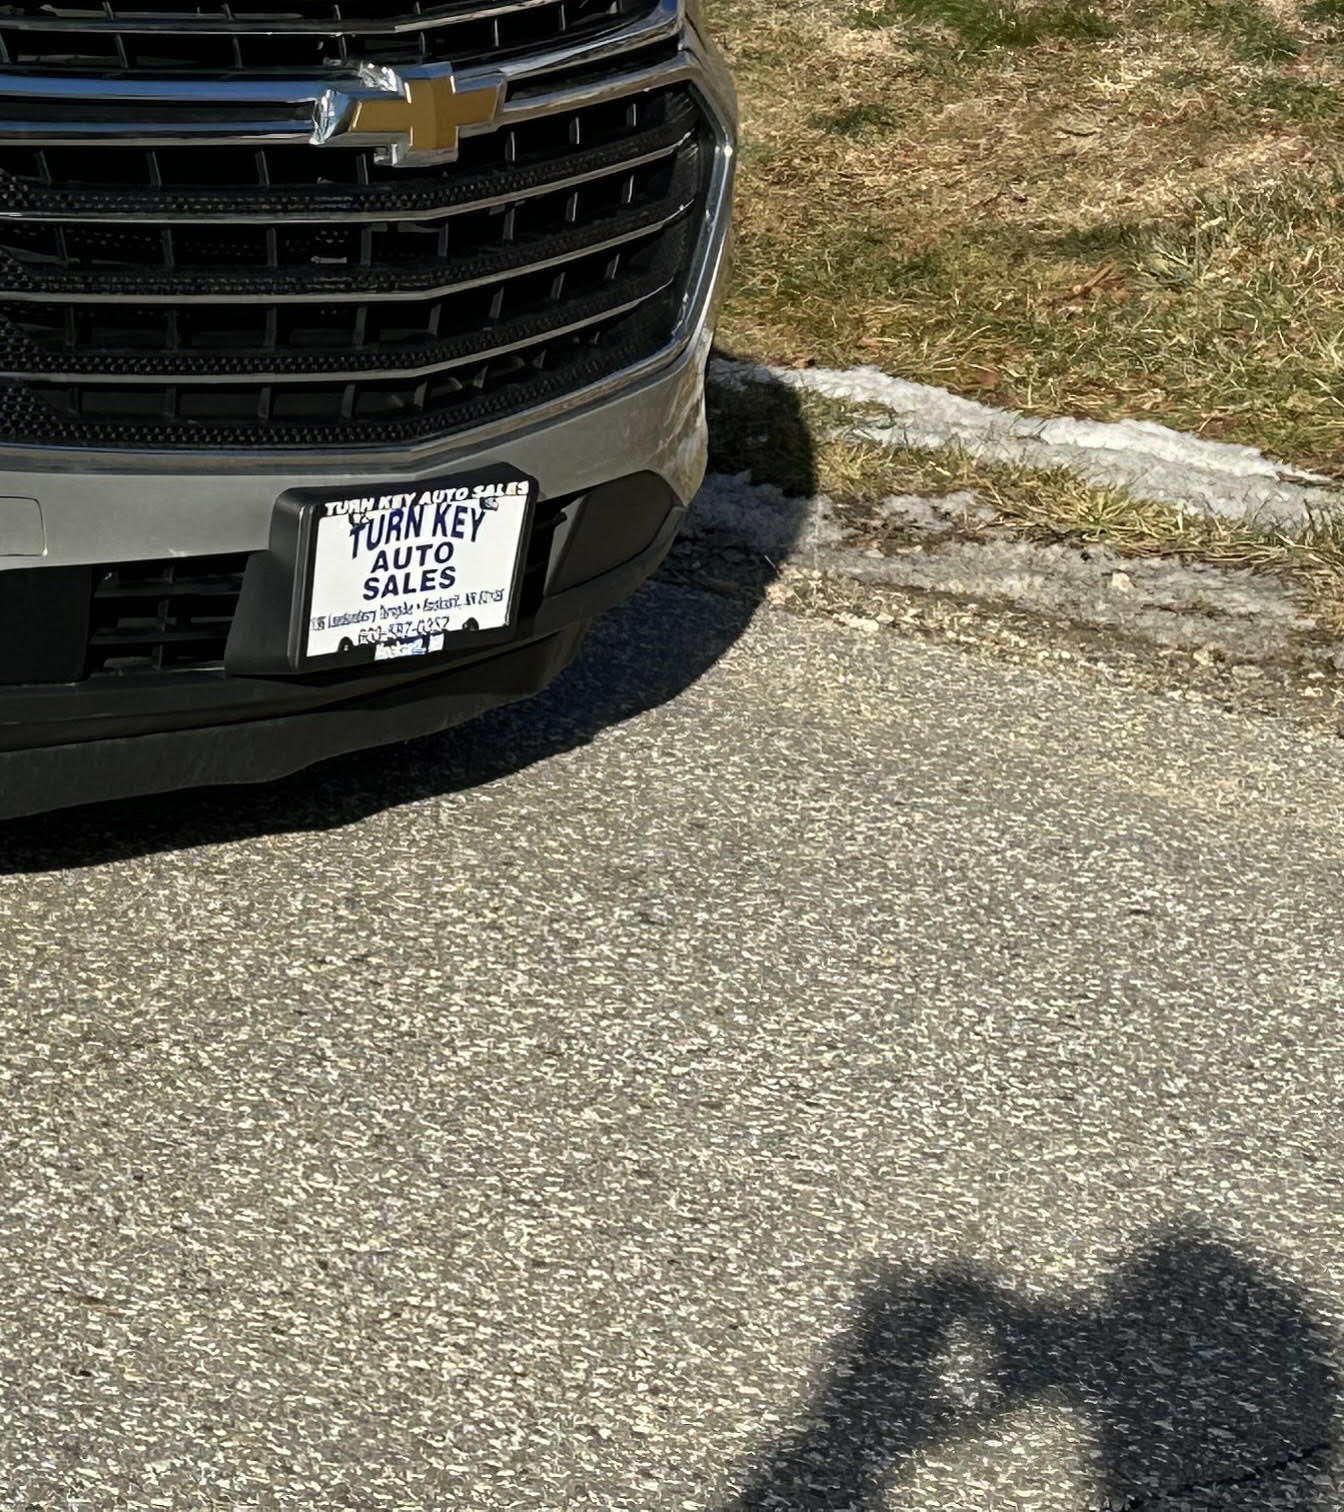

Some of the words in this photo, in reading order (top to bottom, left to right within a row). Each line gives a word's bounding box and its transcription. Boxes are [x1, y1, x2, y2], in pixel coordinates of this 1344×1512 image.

[325, 498, 373, 517] TURN
[378, 492, 417, 510] KEY
[418, 487, 468, 504] AUTO
[472, 480, 530, 499] SALES
[349, 504, 424, 559] TURN
[432, 503, 486, 543] KEY
[370, 541, 455, 574] AUTO
[362, 566, 456, 601] SALES
